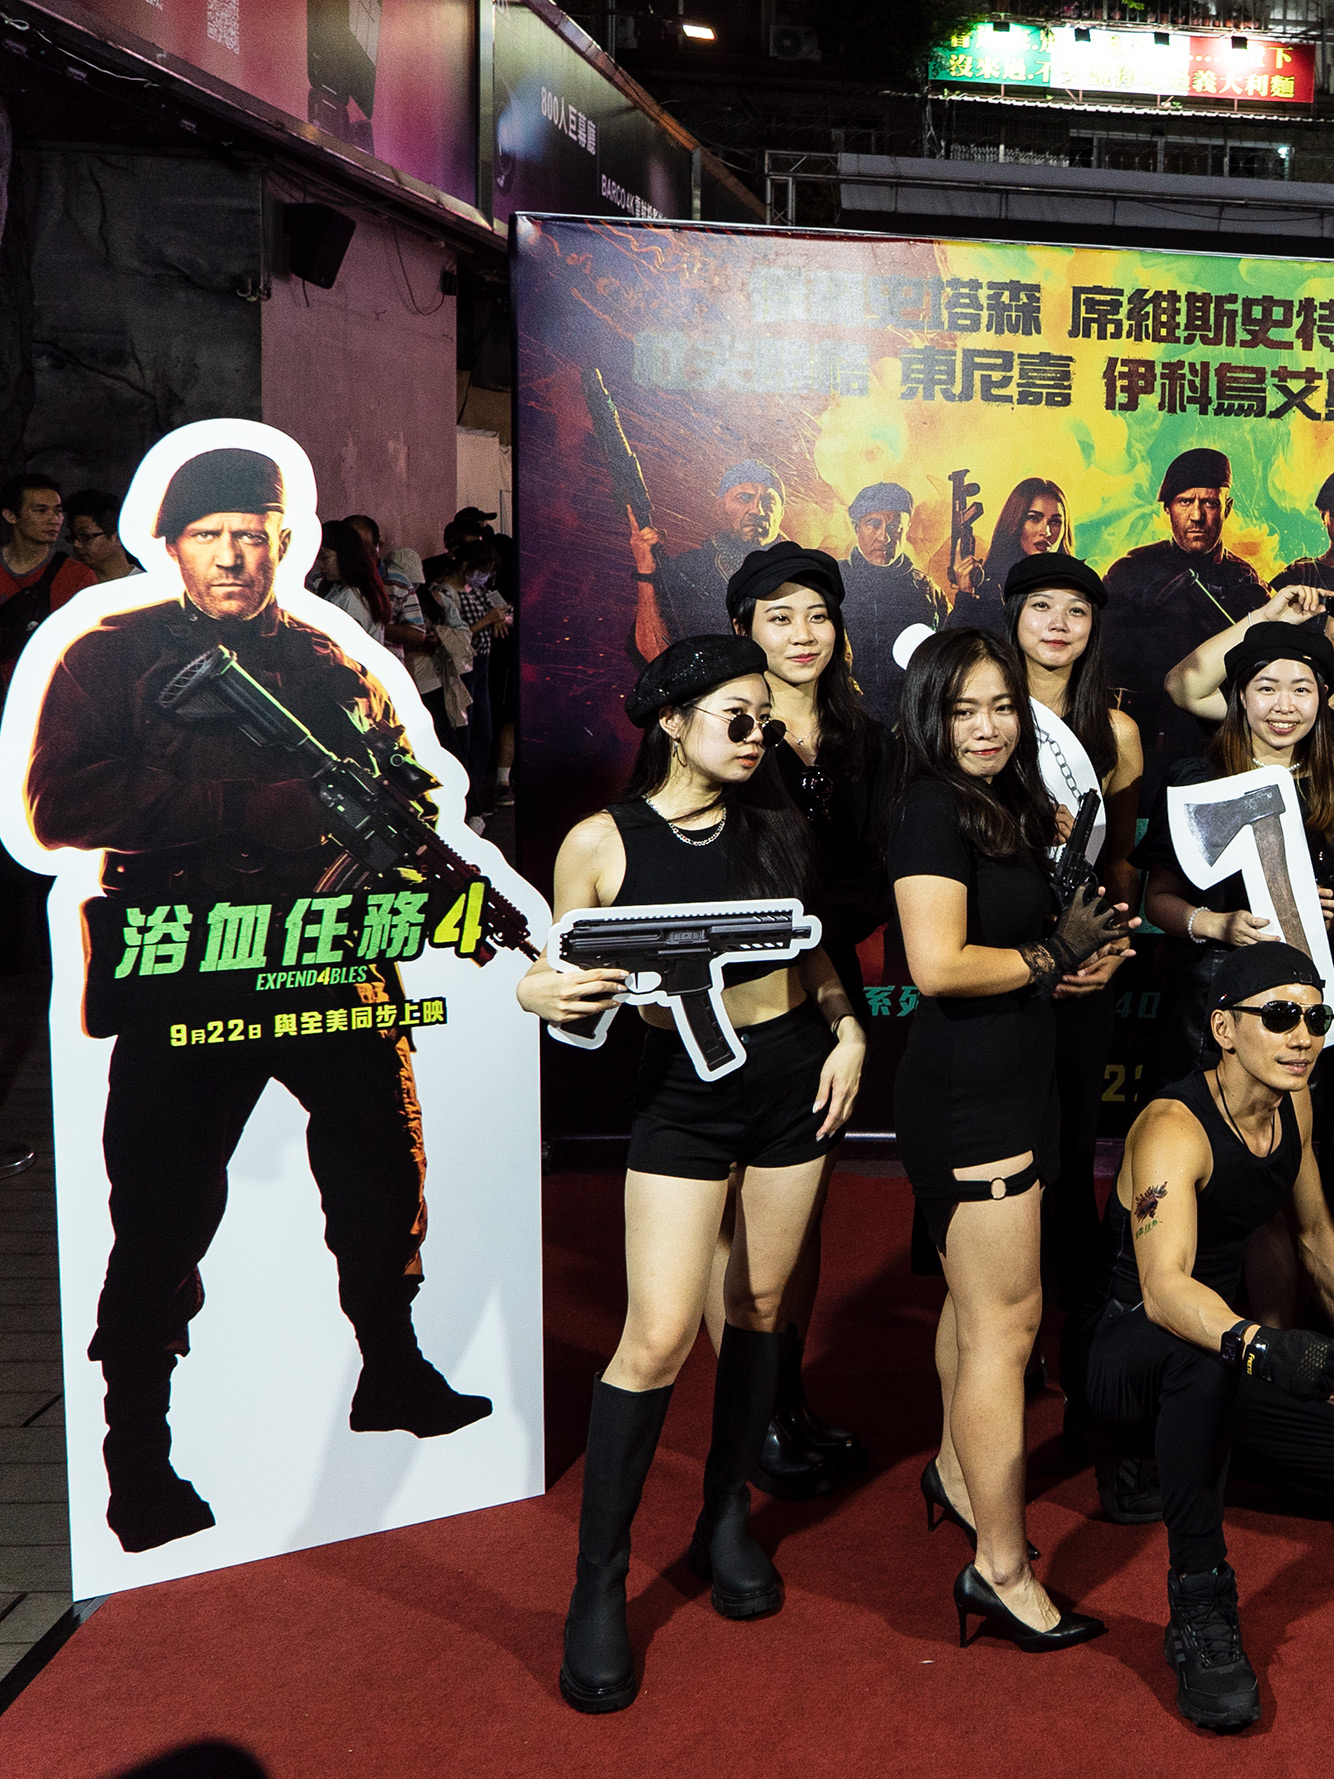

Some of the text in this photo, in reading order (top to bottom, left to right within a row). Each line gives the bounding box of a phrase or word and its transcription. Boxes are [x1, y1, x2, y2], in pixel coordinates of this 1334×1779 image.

[898, 345, 1075, 408] 東尼嘉
[114, 881, 486, 980] 浴血任務4
[255, 964, 369, 992] EXPEND4BLES
[170, 999, 447, 1048] 9月22日 與全美同步上映
